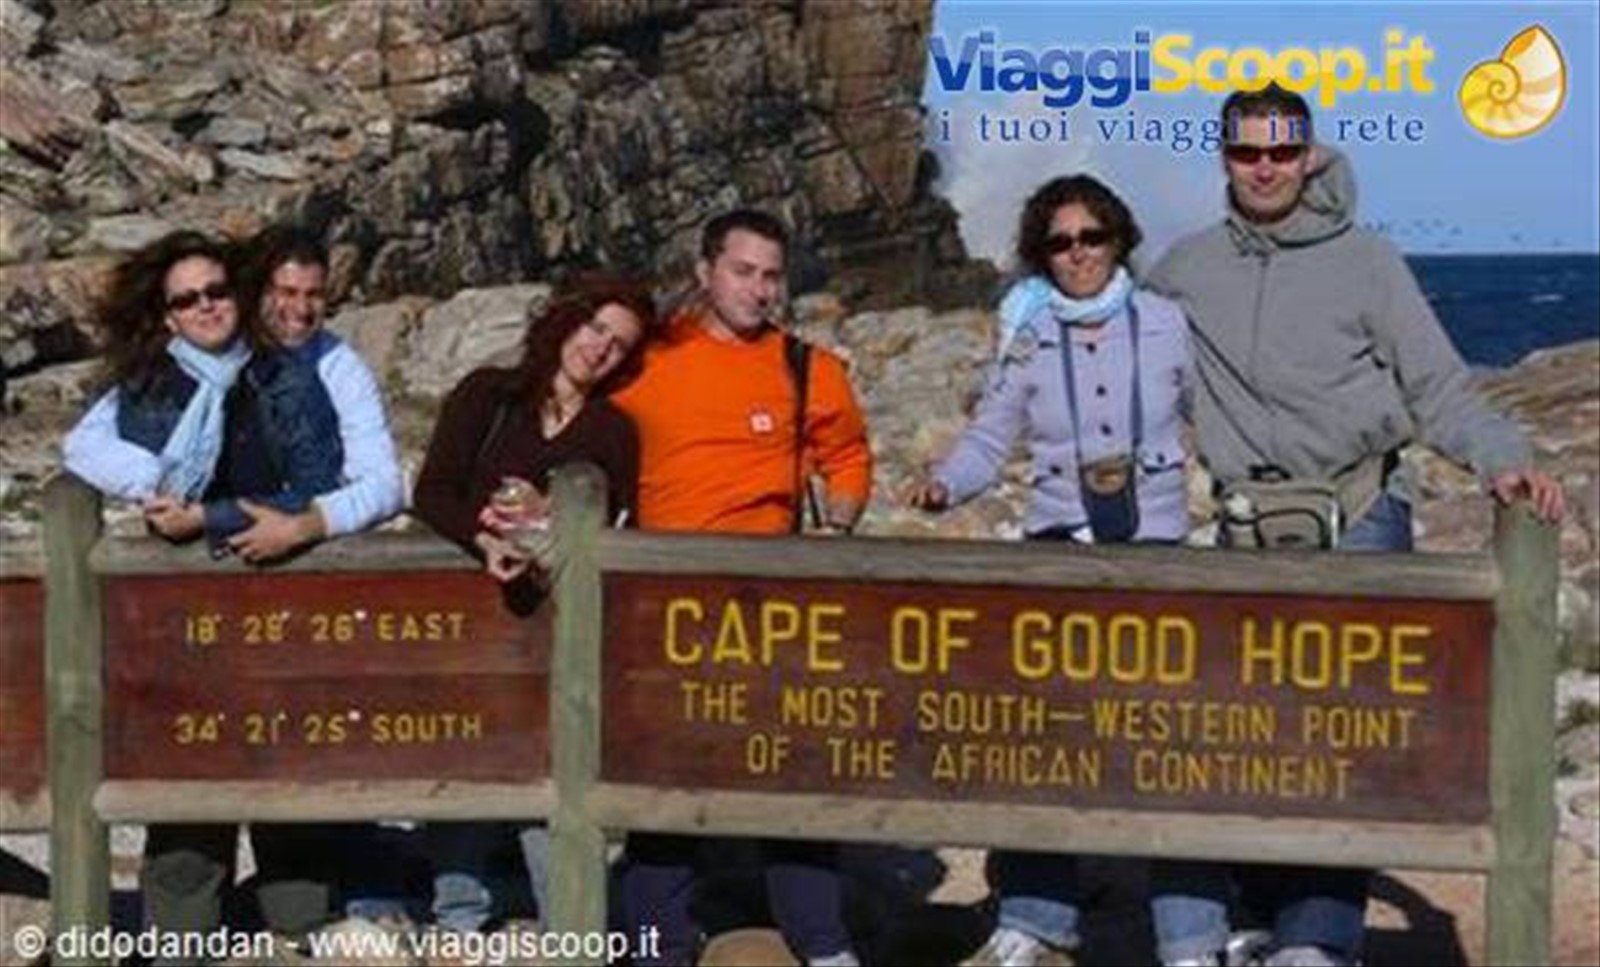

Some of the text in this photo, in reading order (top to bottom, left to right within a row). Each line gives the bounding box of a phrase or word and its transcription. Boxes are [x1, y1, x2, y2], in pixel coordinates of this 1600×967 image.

[377, 612, 466, 641] EAST
[664, 598, 1432, 695] CAPE OF GOOD HOPE
[371, 714, 484, 744] SOUTH
[681, 682, 748, 725] THE
[781, 687, 885, 730] MOST
[1303, 706, 1416, 750] POINT
[746, 733, 1355, 801] OF THE AFRICAN CONTINENT
